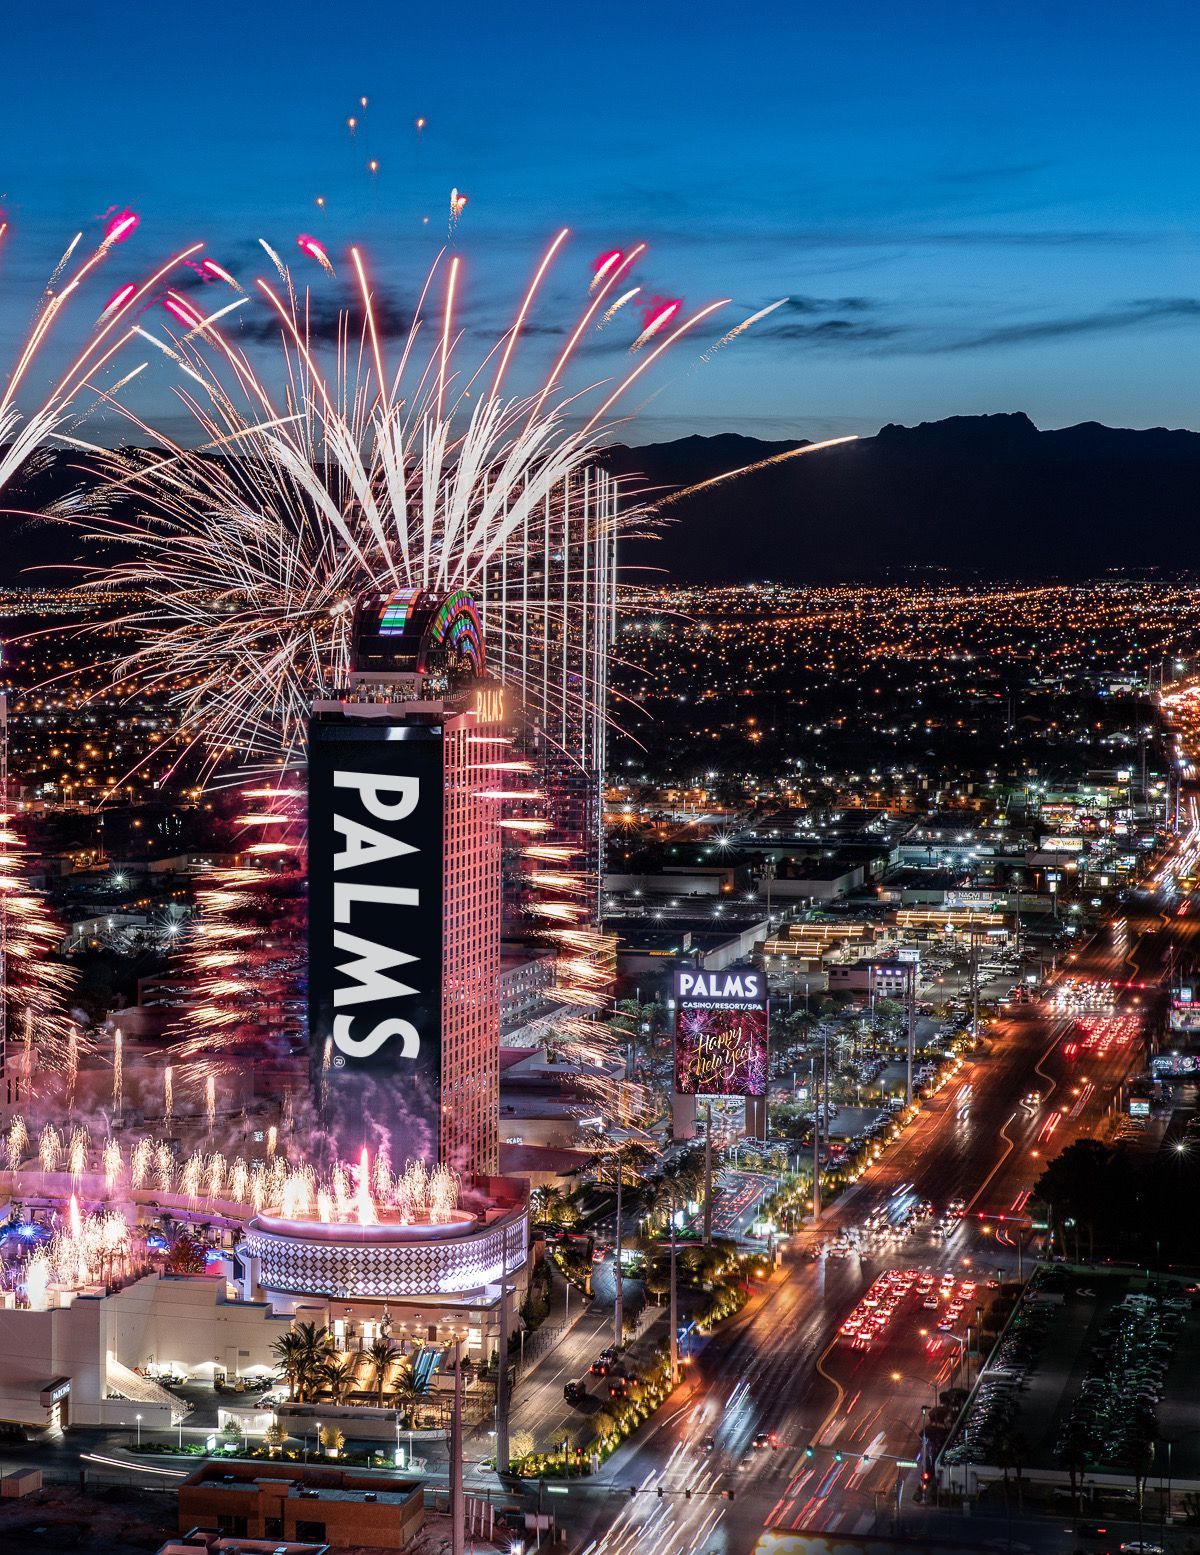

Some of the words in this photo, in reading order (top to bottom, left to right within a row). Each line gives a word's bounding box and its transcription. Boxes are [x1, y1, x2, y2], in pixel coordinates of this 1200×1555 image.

[476, 689, 504, 723] PALMS
[333, 770, 421, 1059] PALMS
[680, 974, 757, 997] PALMS
[682, 1002, 762, 1010] CASINO/RESORT/SPA
[690, 1027, 742, 1059] Happy
[688, 1054, 722, 1077] New
[53, 1384, 70, 1401] PARKING
